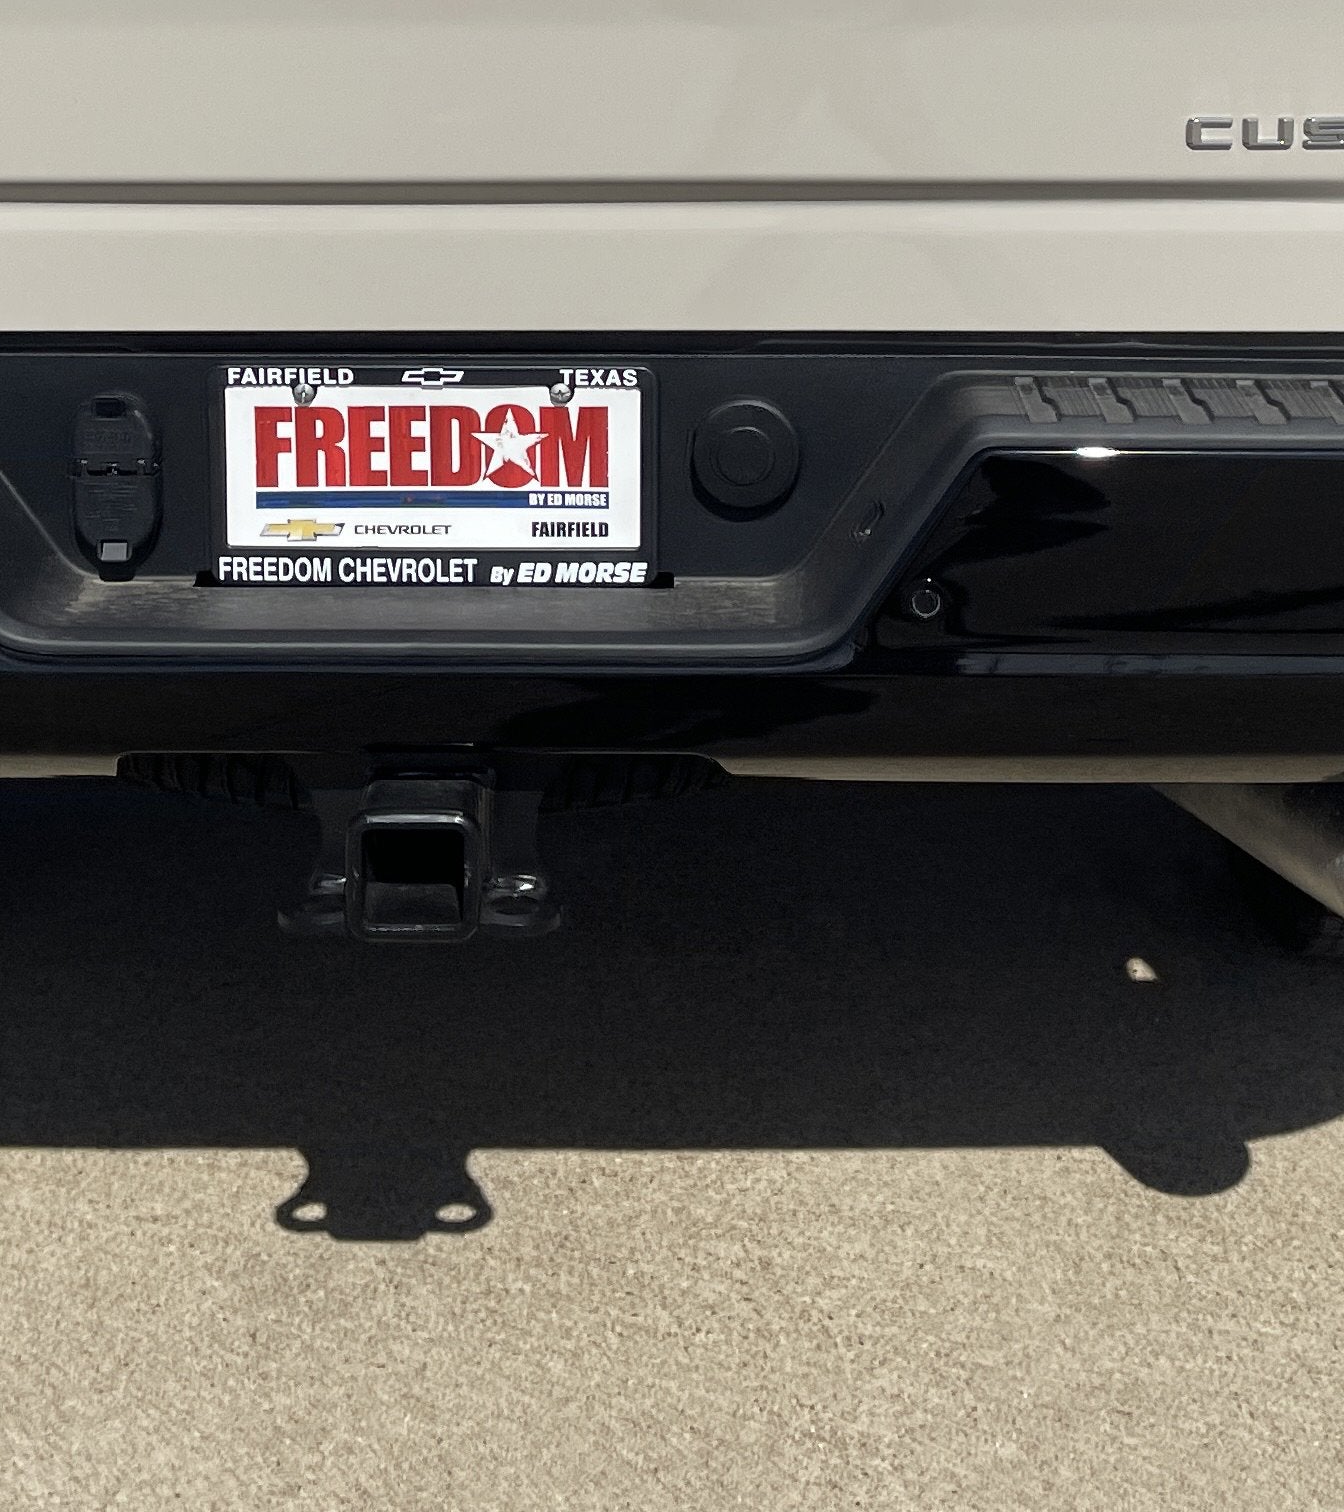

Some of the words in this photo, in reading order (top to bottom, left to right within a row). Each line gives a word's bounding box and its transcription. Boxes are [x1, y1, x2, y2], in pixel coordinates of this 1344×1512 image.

[227, 368, 354, 385] FAIRFIELD
[560, 369, 638, 386] TEXAS
[254, 405, 609, 488] FREEDOM
[529, 494, 544, 506] BY
[547, 494, 562, 506] ED
[565, 494, 607, 506] MORSE
[354, 524, 453, 536] CHEVROLET
[531, 521, 610, 538] FAIRFIELD
[218, 556, 333, 582] FREEDOM
[338, 558, 478, 583] CHEVROLET
[490, 566, 514, 585] By
[516, 563, 552, 583] ED
[556, 562, 648, 584] MORSE
